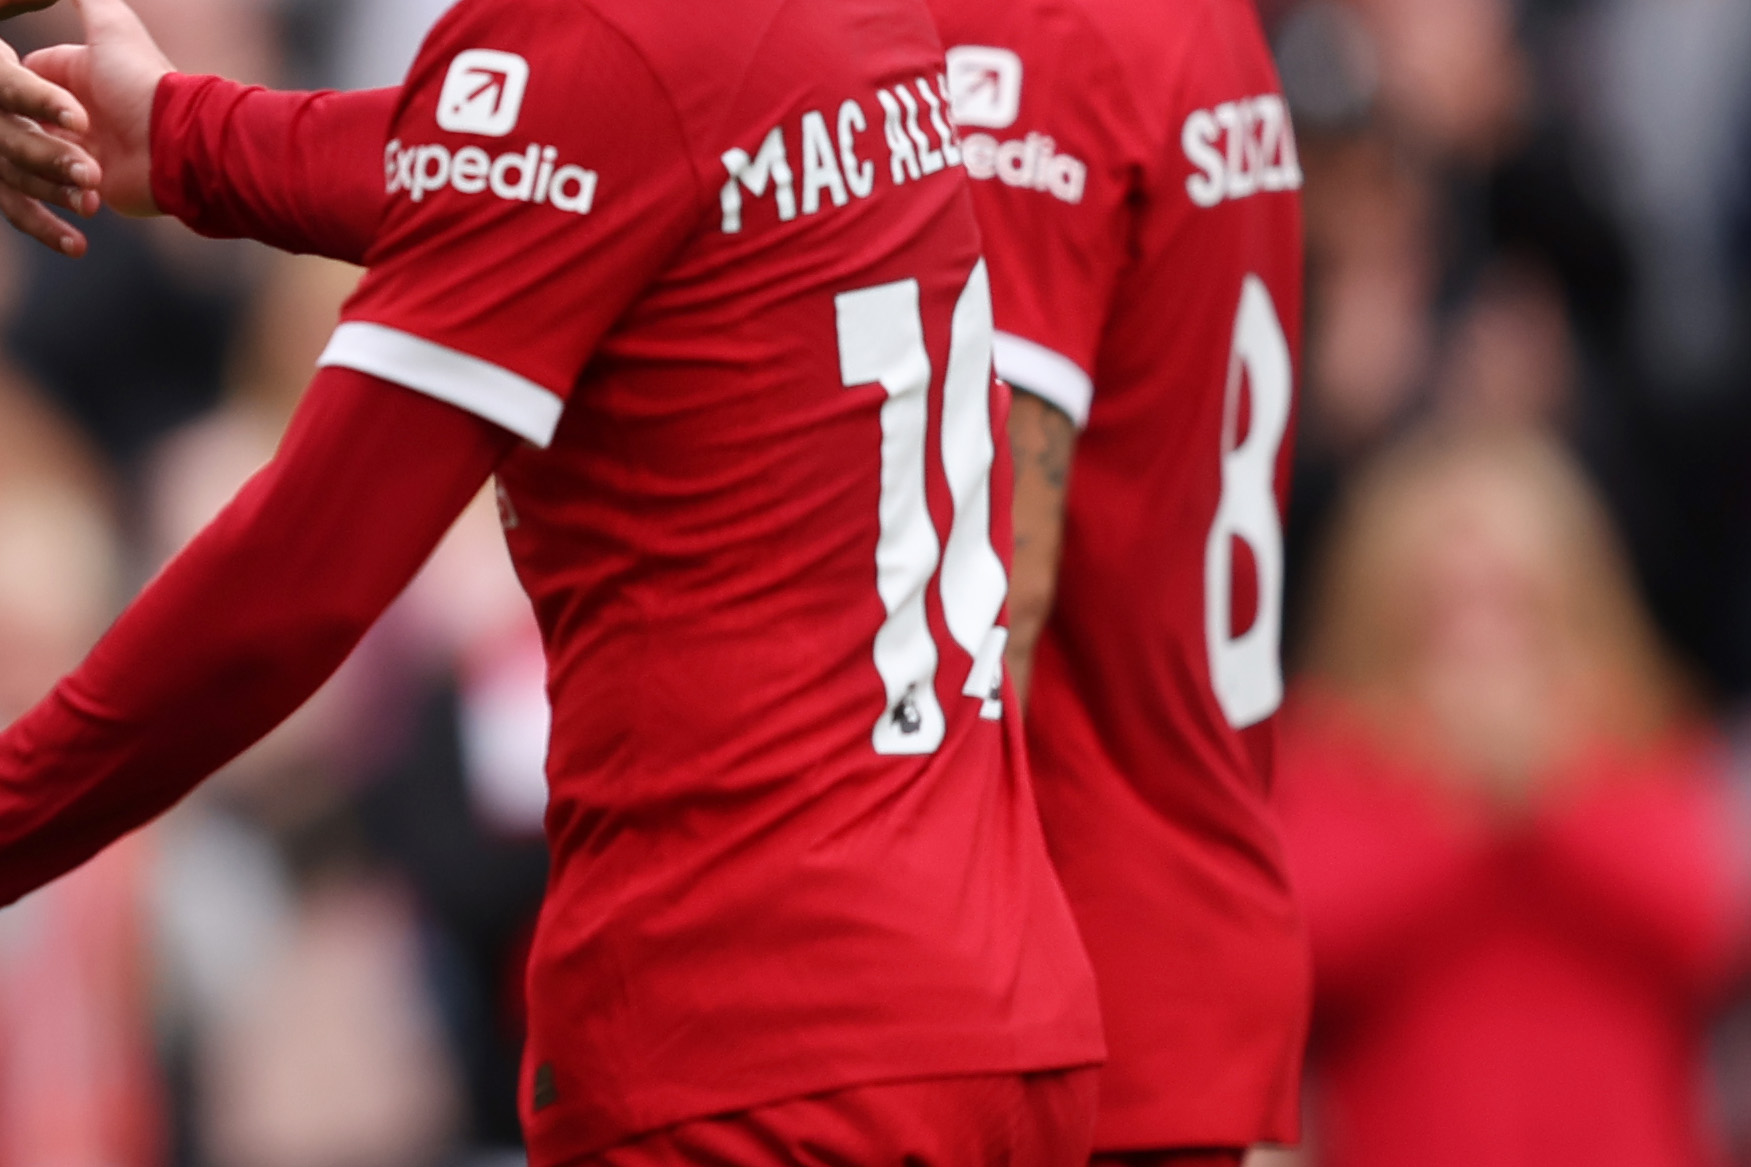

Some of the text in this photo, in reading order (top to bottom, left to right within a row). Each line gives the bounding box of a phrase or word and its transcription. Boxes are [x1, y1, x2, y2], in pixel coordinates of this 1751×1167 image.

[384, 137, 599, 215] Expedia
[719, 98, 875, 234] MAC
[1204, 272, 1292, 730] 8
